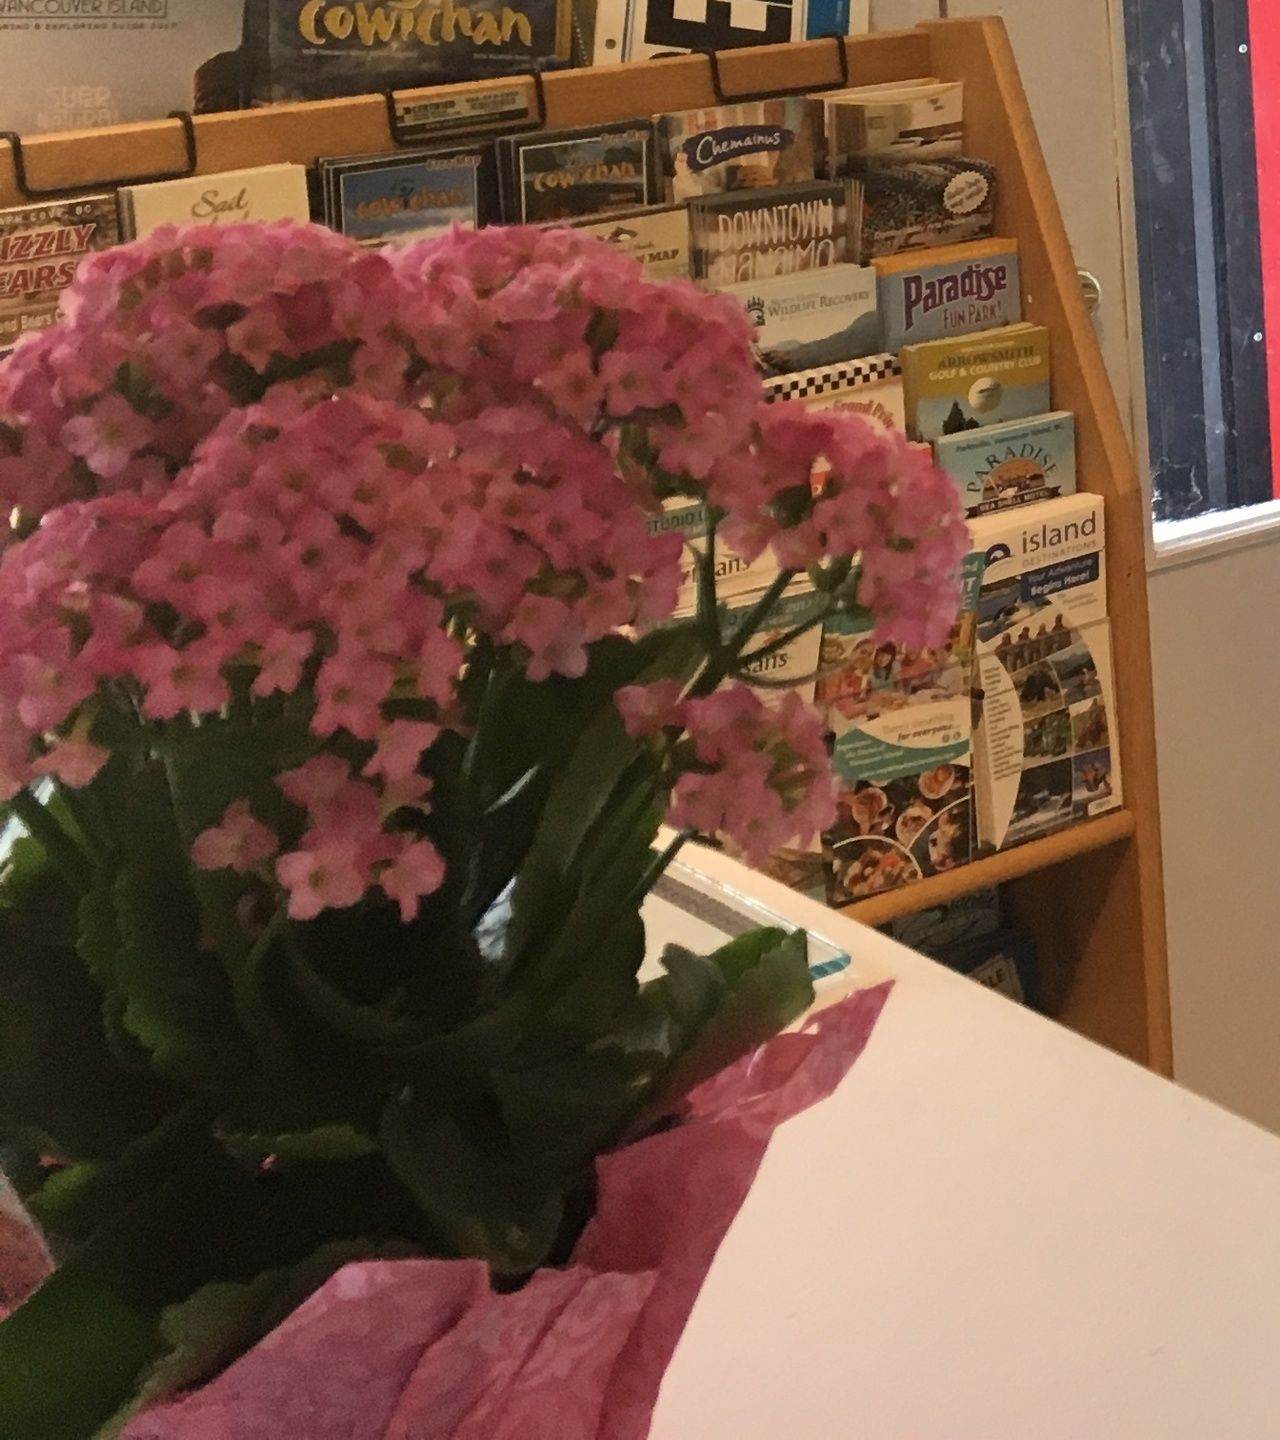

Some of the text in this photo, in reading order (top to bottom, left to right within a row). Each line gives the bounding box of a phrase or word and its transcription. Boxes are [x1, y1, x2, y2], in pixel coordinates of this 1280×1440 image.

[695, 129, 782, 165] Chemainus
[0, 223, 97, 263] IZZLY
[718, 198, 834, 253] DOWNTOWN
[648, 249, 680, 263] MAP
[767, 300, 817, 317] WILDLIFE
[819, 290, 870, 308] RECOVERY
[903, 263, 1007, 332] Paradise
[943, 310, 966, 330] FUN
[929, 355, 1041, 381] GOLF & COUNTRY CLUB
[966, 443, 1058, 494] PARADISE
[1021, 510, 1097, 554] island
[1021, 540, 1098, 569] DESTINATIONS
